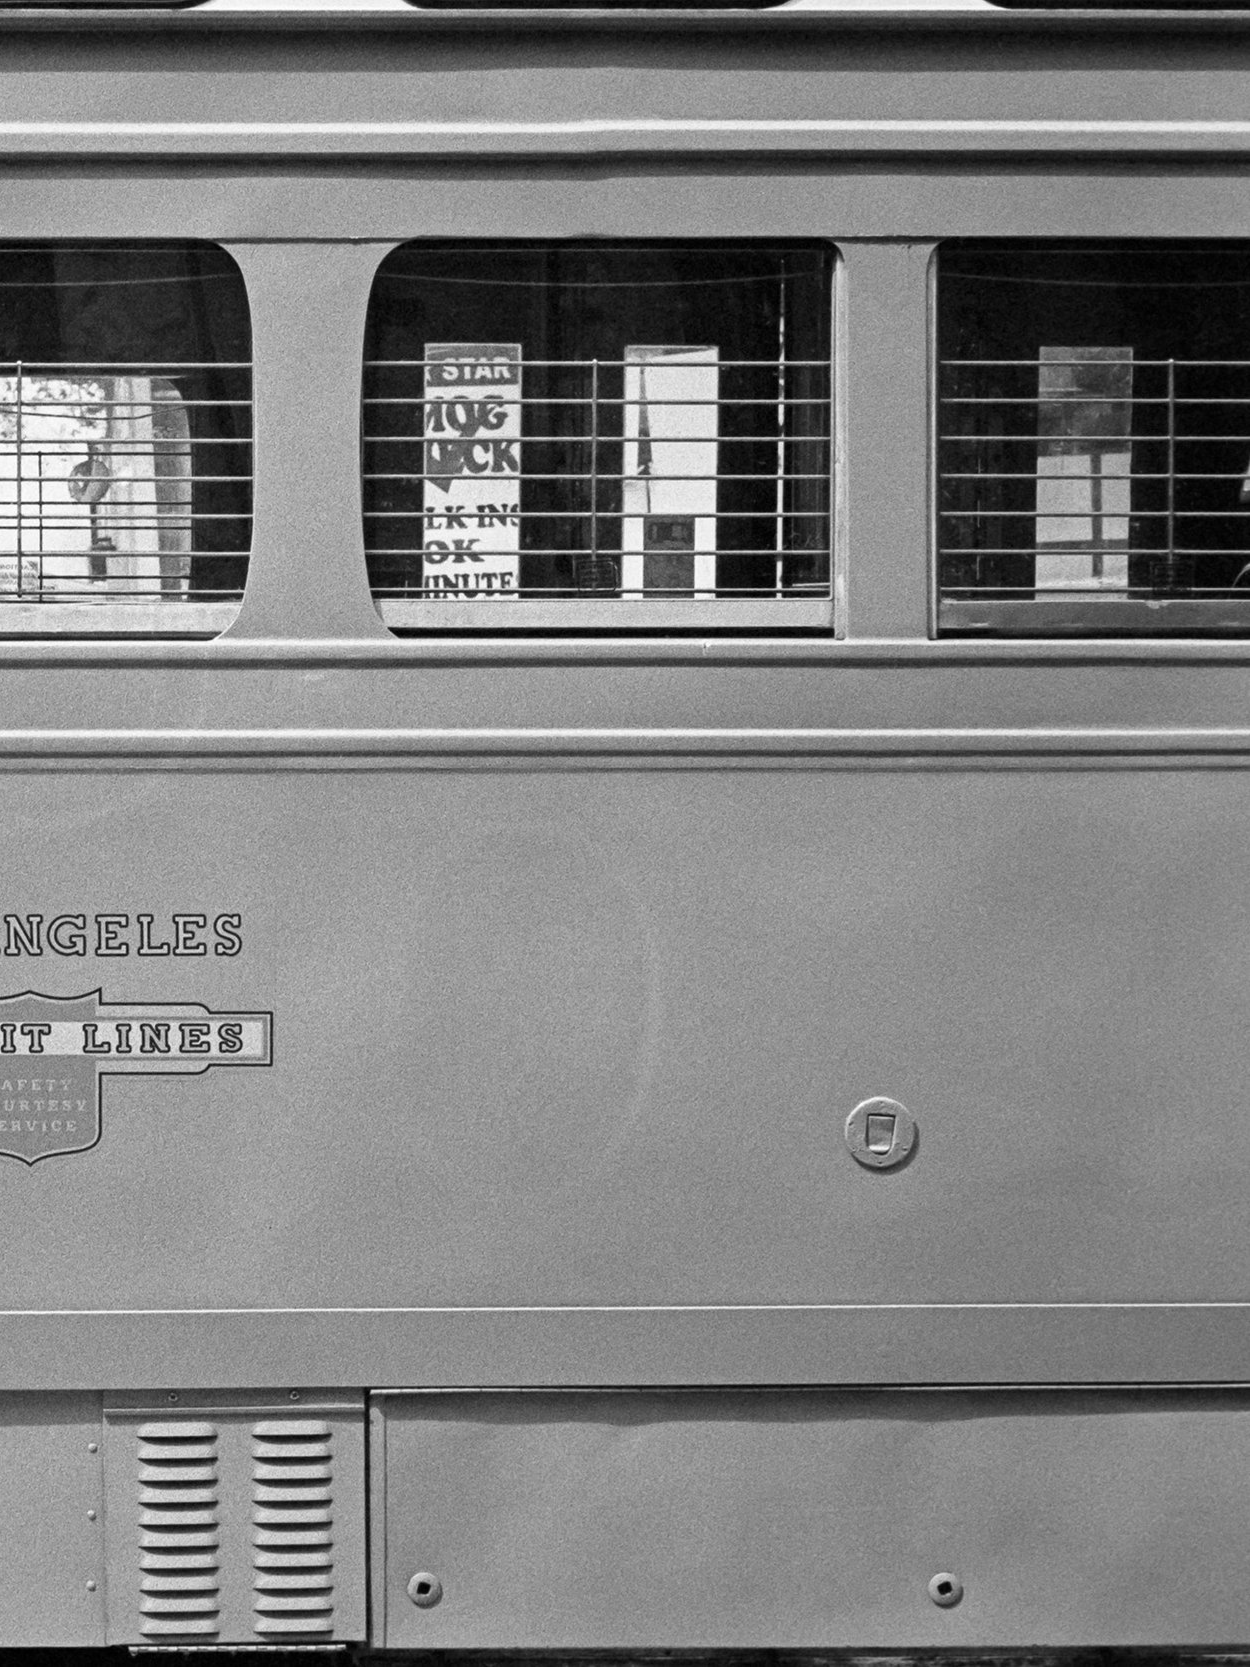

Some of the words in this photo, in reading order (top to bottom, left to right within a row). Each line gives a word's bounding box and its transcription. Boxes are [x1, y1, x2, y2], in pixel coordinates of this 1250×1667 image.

[442, 357, 511, 380] STAR
[425, 539, 485, 564] OK
[82, 1022, 244, 1054] LINES
